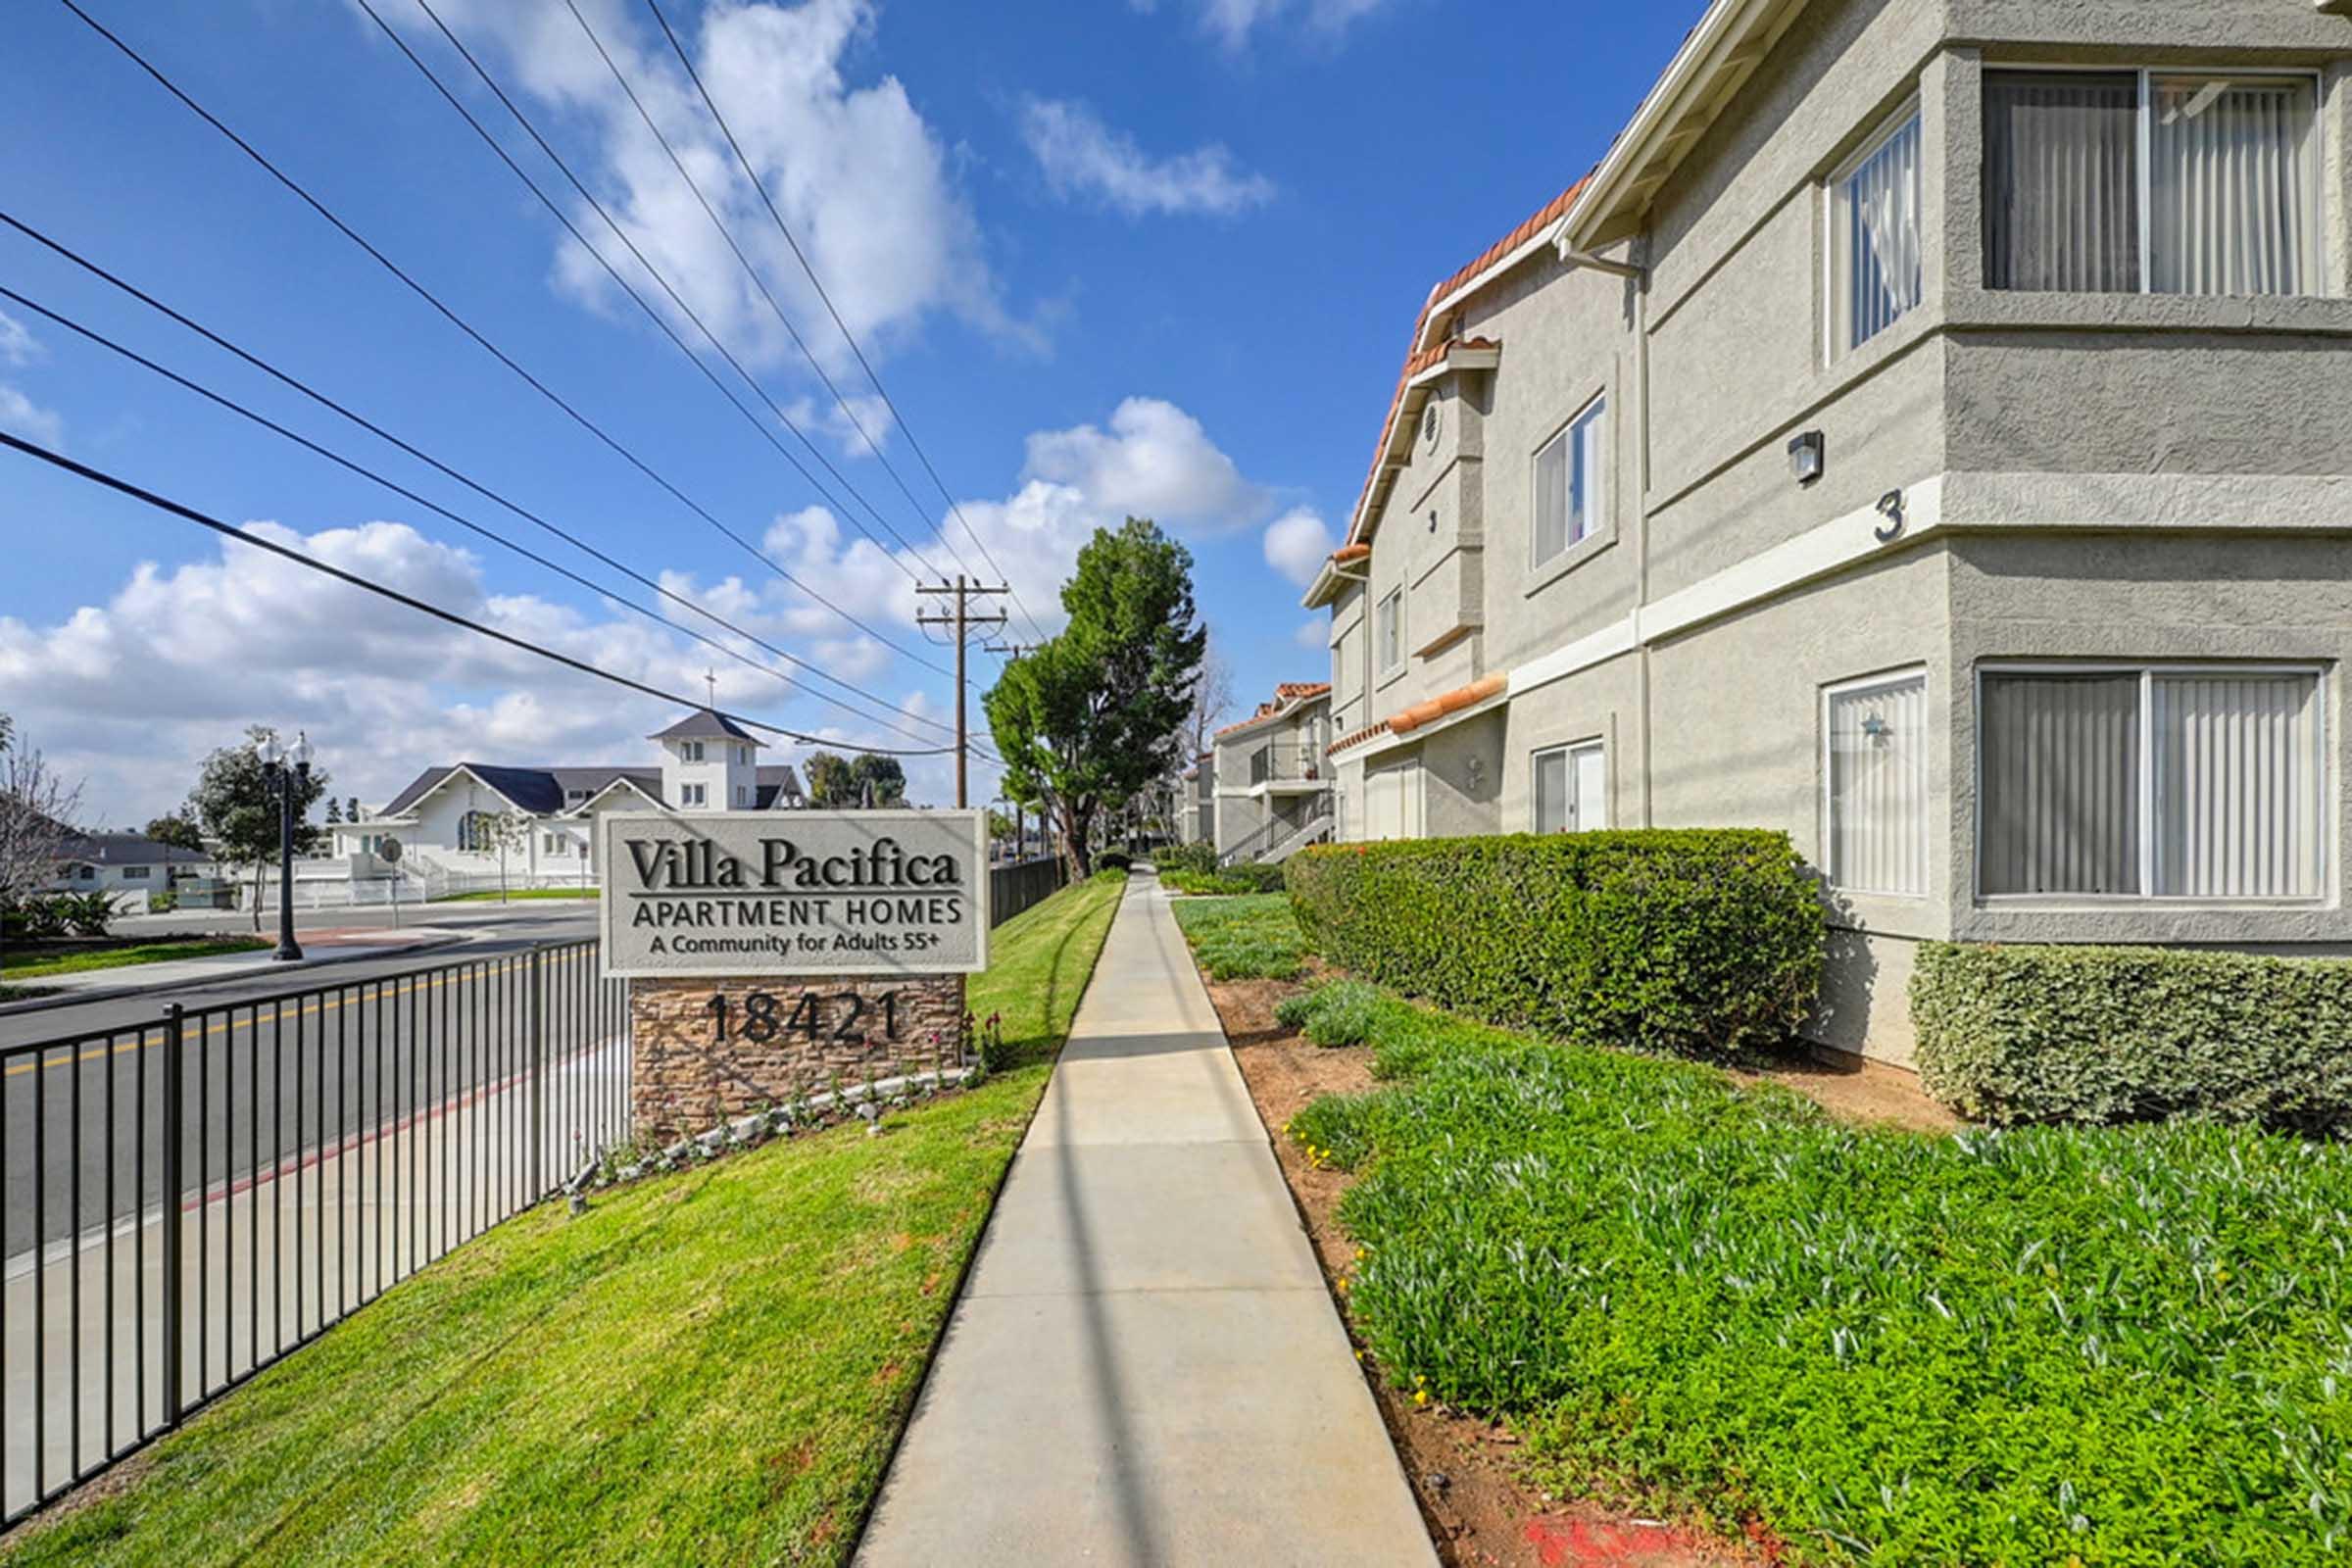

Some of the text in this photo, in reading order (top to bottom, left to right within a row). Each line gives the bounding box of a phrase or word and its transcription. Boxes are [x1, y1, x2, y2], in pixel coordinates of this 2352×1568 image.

[1875, 489, 1903, 543] 3
[624, 837, 960, 890] Villa Pacifica
[632, 898, 962, 927] APARTMENT HOMES
[649, 932, 941, 956] A Community for Adults 55+
[708, 990, 896, 1044] 18421
